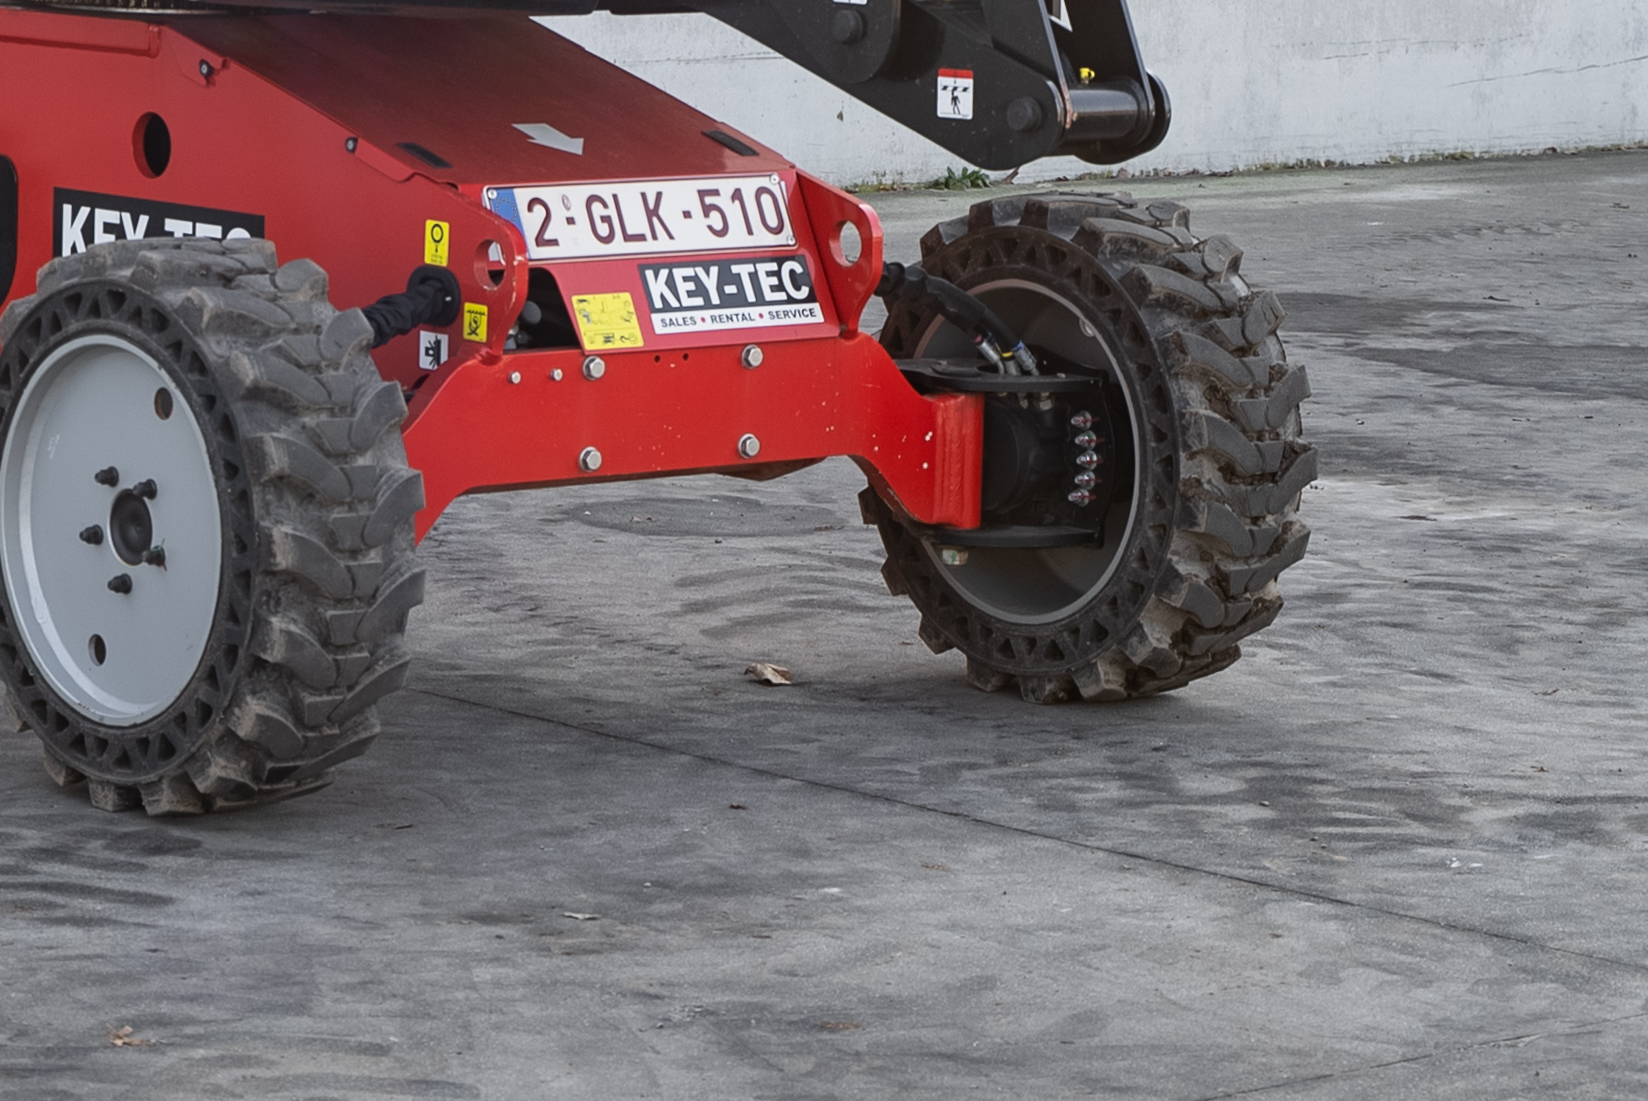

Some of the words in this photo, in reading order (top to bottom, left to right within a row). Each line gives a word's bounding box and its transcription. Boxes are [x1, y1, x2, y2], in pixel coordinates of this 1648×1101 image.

[644, 260, 811, 310] KEY-TEC
[660, 316, 698, 328] SALES
[710, 311, 756, 324] RENTAL
[767, 307, 818, 320] SERVICE
